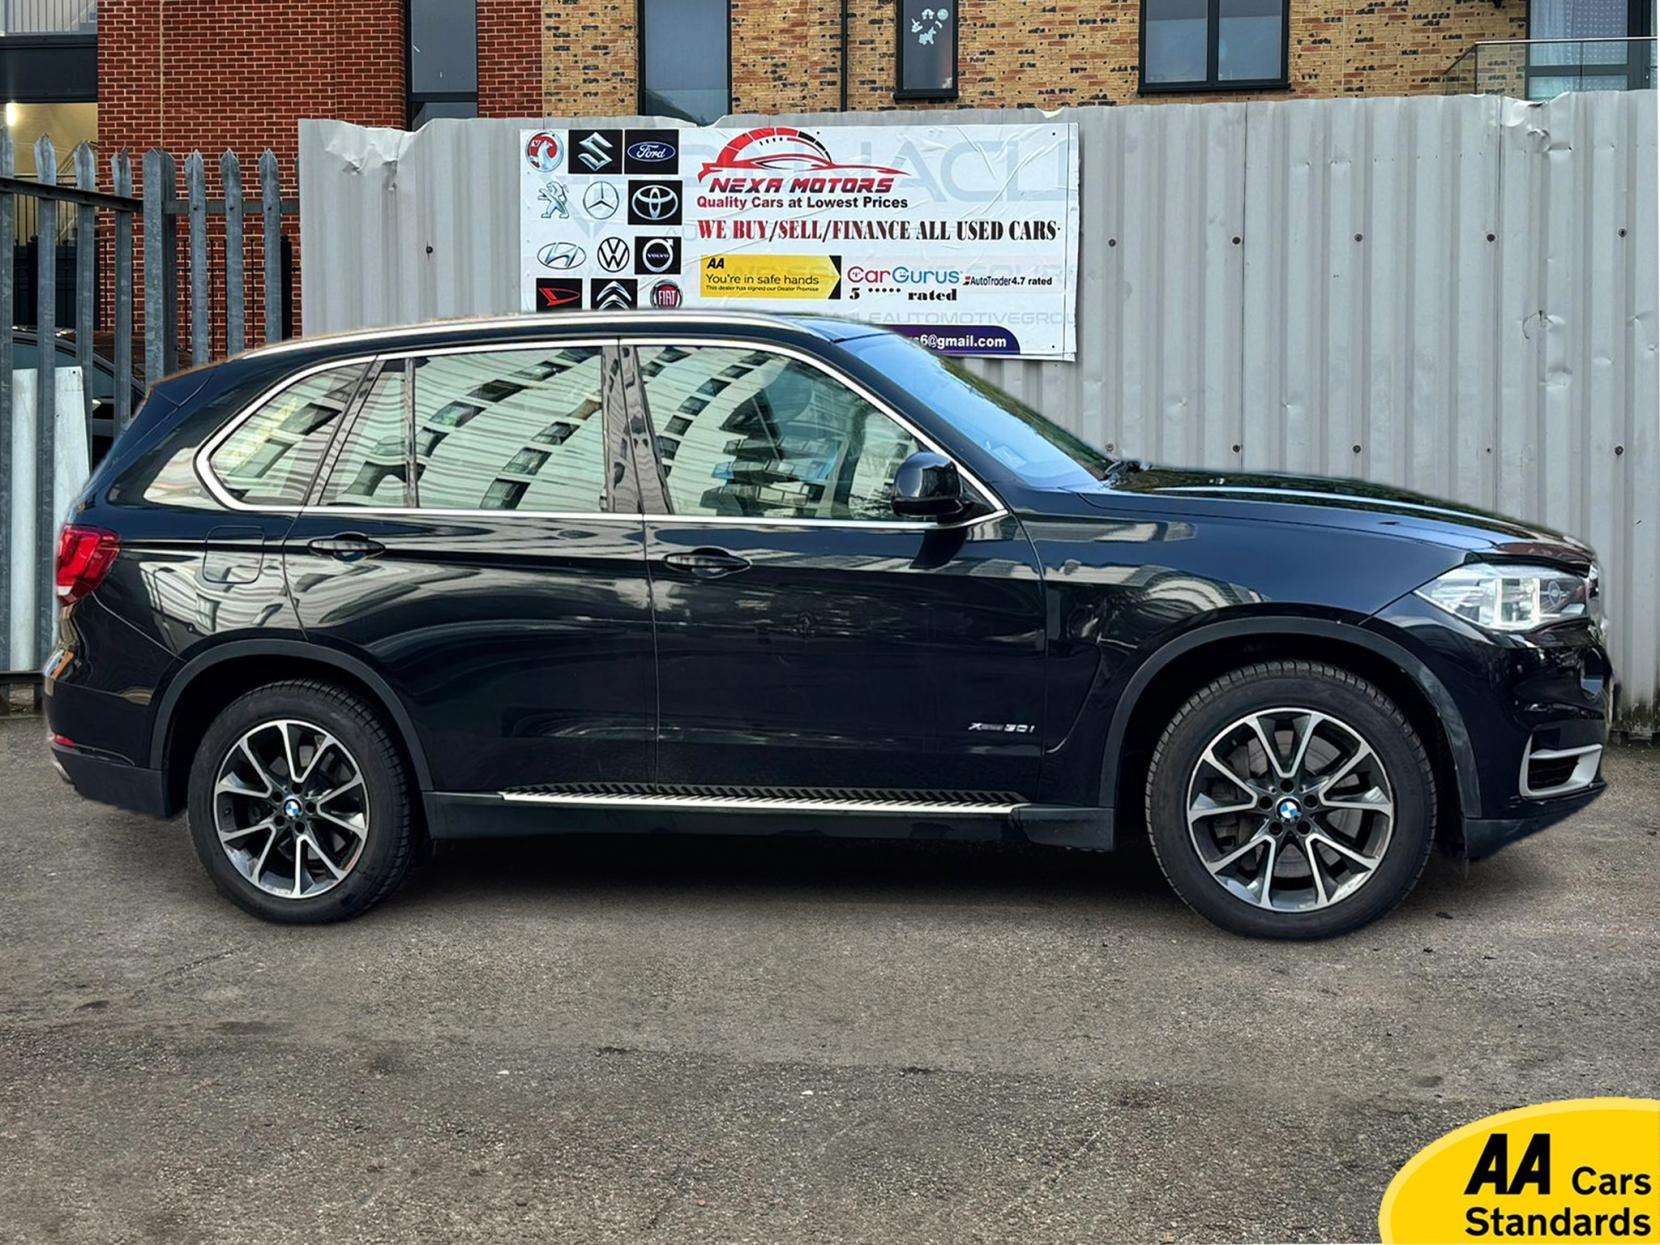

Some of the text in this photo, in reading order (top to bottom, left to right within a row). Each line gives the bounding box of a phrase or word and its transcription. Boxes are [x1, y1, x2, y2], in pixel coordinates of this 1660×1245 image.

[636, 144, 666, 159] Ford
[709, 178, 894, 193] NEXA MOTORS
[697, 196, 908, 210] Quality Cars at Lowest Prices
[697, 219, 727, 239] WE
[733, 219, 911, 243] BUY/SELL/FINANCE
[916, 220, 950, 241] ALL
[956, 220, 1004, 241] USED
[1009, 220, 1057, 241] CARS
[707, 257, 725, 269] AA
[705, 273, 820, 286] You're in safe hands
[847, 266, 960, 284] CarGurus
[1028, 277, 1053, 286] rated
[658, 290, 676, 305] FIAT
[849, 287, 958, 301] 5 rated
